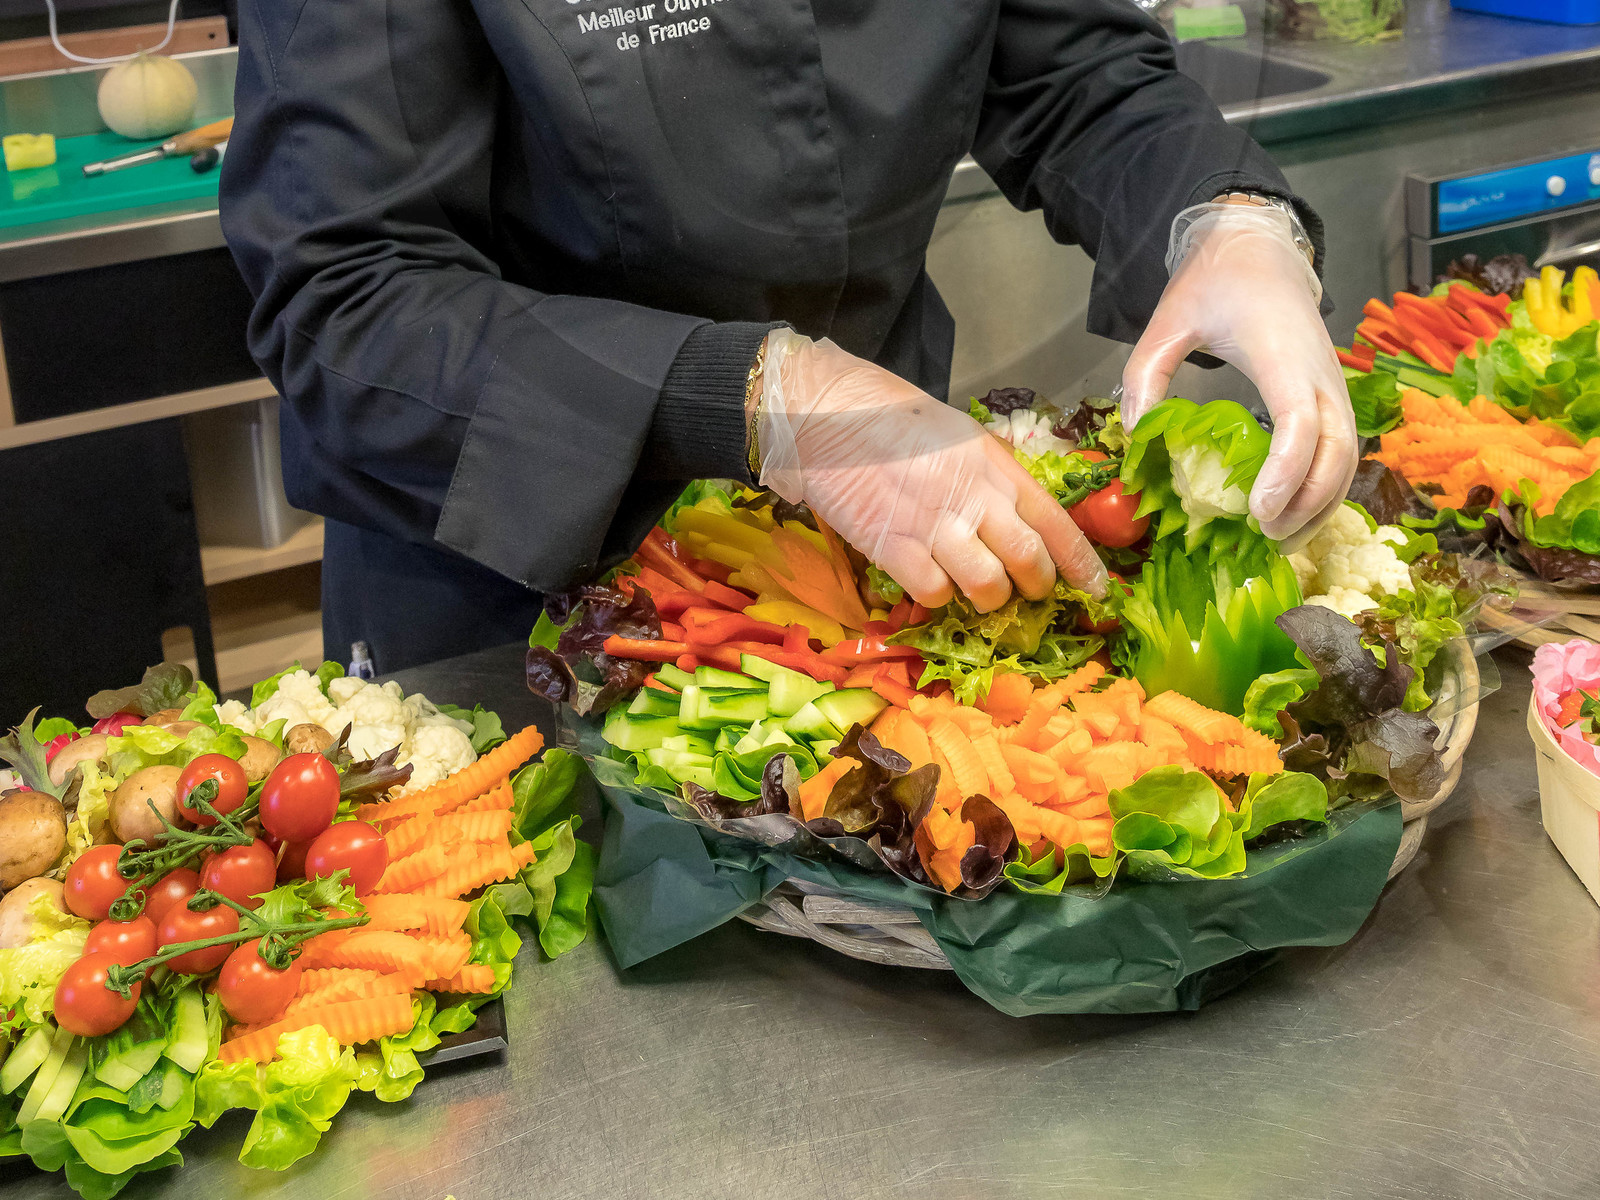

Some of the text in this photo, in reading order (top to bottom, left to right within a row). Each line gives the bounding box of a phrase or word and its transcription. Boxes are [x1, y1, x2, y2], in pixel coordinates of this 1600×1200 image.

[577, 3, 656, 34] Meilleur
[616, 16, 711, 51] de France
